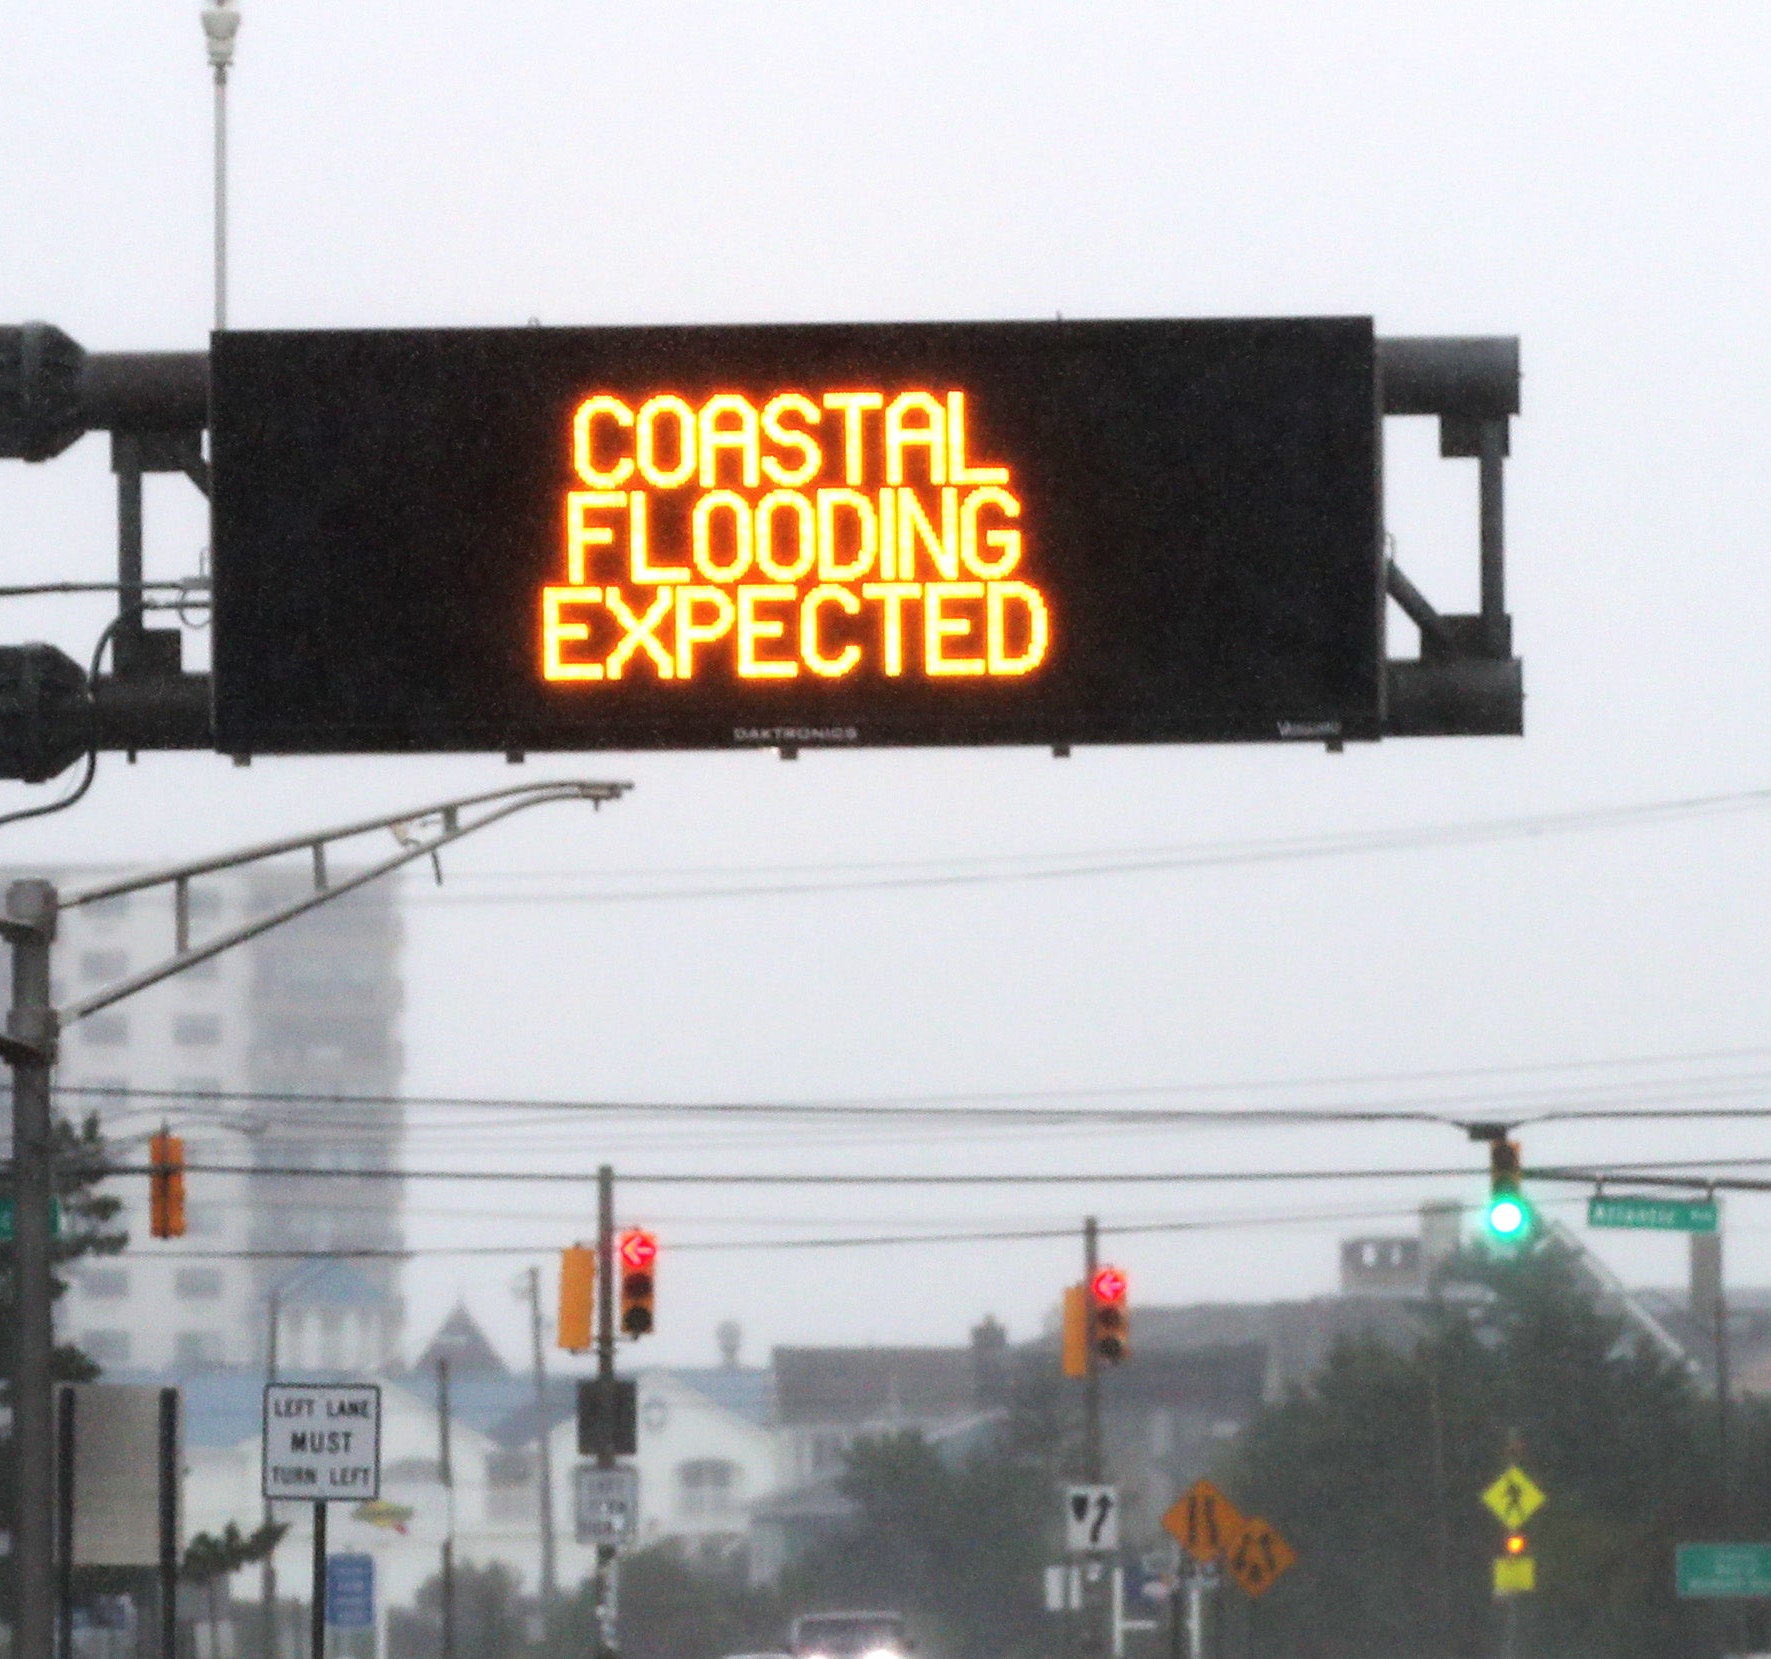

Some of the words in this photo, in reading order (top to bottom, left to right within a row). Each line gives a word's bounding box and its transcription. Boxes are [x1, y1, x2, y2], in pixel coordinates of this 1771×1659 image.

[572, 389, 1010, 490] COASTAL
[566, 486, 1022, 585] FLOODING
[542, 580, 1049, 682] EXPECTED
[274, 1399, 314, 1418] LEFT
[326, 1400, 369, 1419] LANE
[290, 1430, 352, 1454] MUST
[272, 1465, 317, 1485] TURN
[329, 1466, 370, 1486] LEFT
